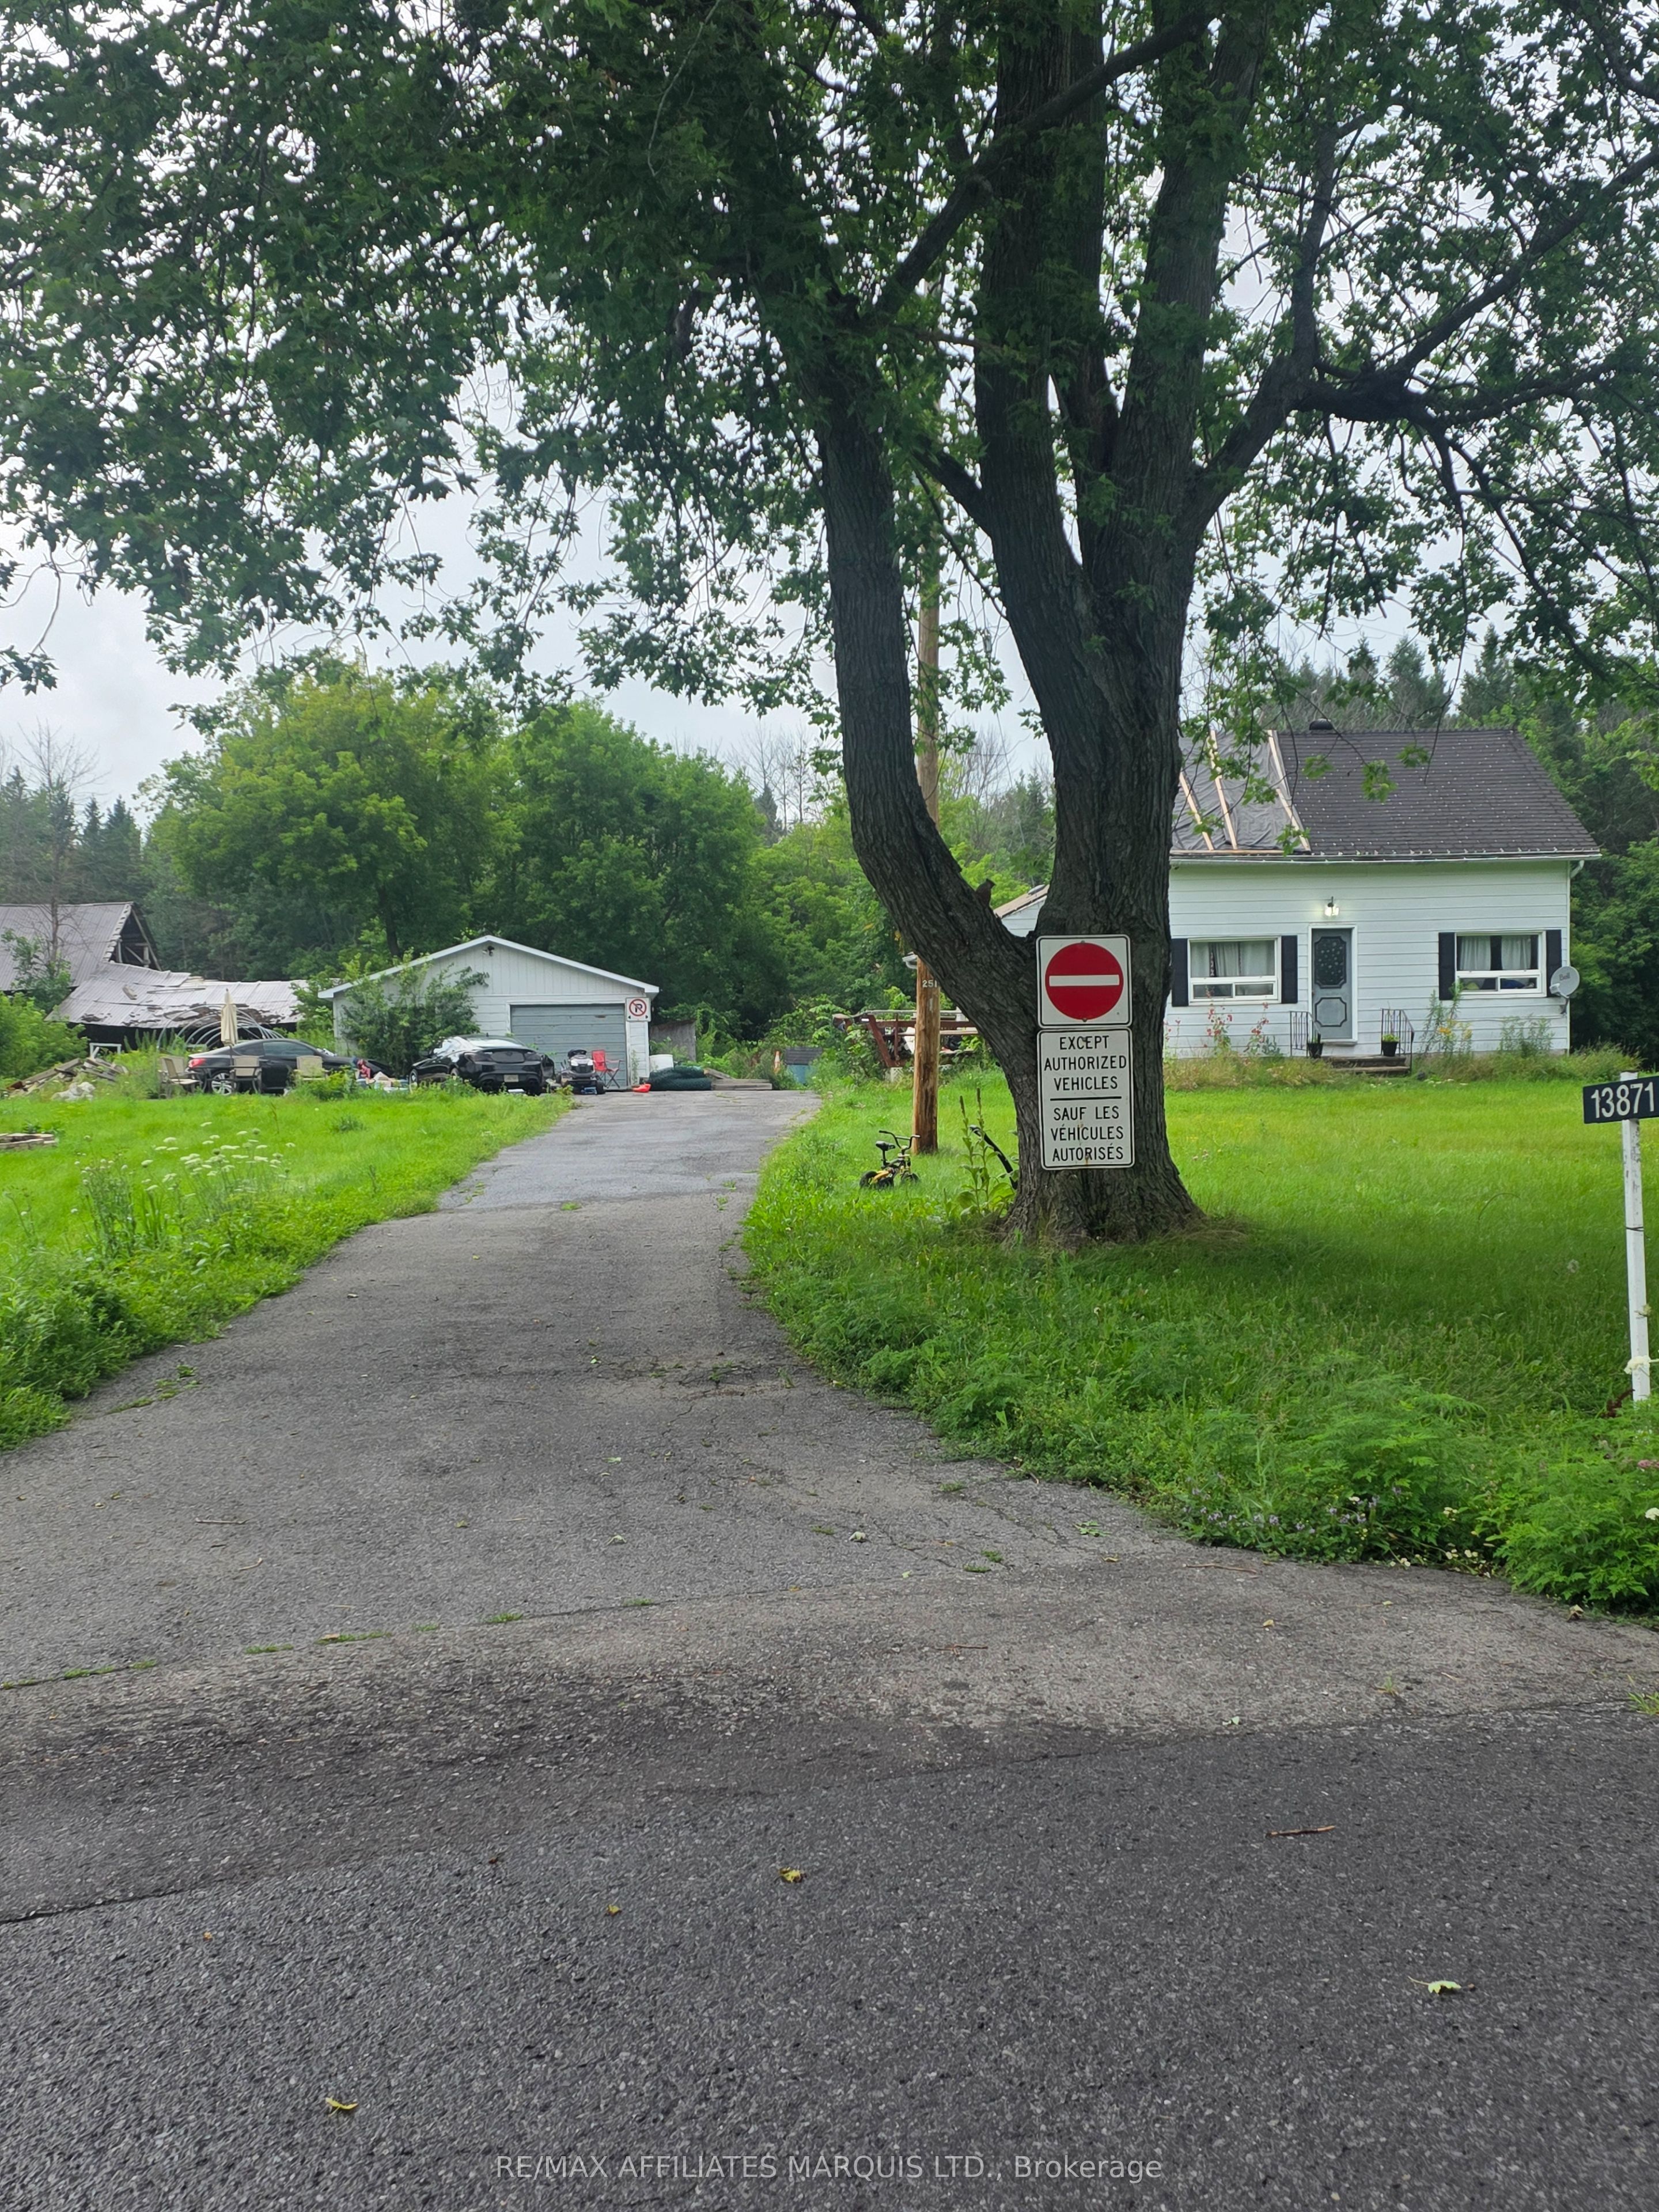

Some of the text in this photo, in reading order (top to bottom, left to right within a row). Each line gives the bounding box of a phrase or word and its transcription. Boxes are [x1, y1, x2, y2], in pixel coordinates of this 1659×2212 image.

[922, 979, 937, 988] 251
[1060, 1035, 1109, 1050] EXCEPT
[1044, 1055, 1127, 1071] AUTHORIZED
[1054, 1075, 1118, 1091] VEHICLES
[1590, 1082, 1654, 1118] 13871
[1054, 1105, 1119, 1121] SAUF LES
[1051, 1124, 1124, 1141] VÉHICULES
[1052, 1143, 1124, 1162] AUTORISÉS
